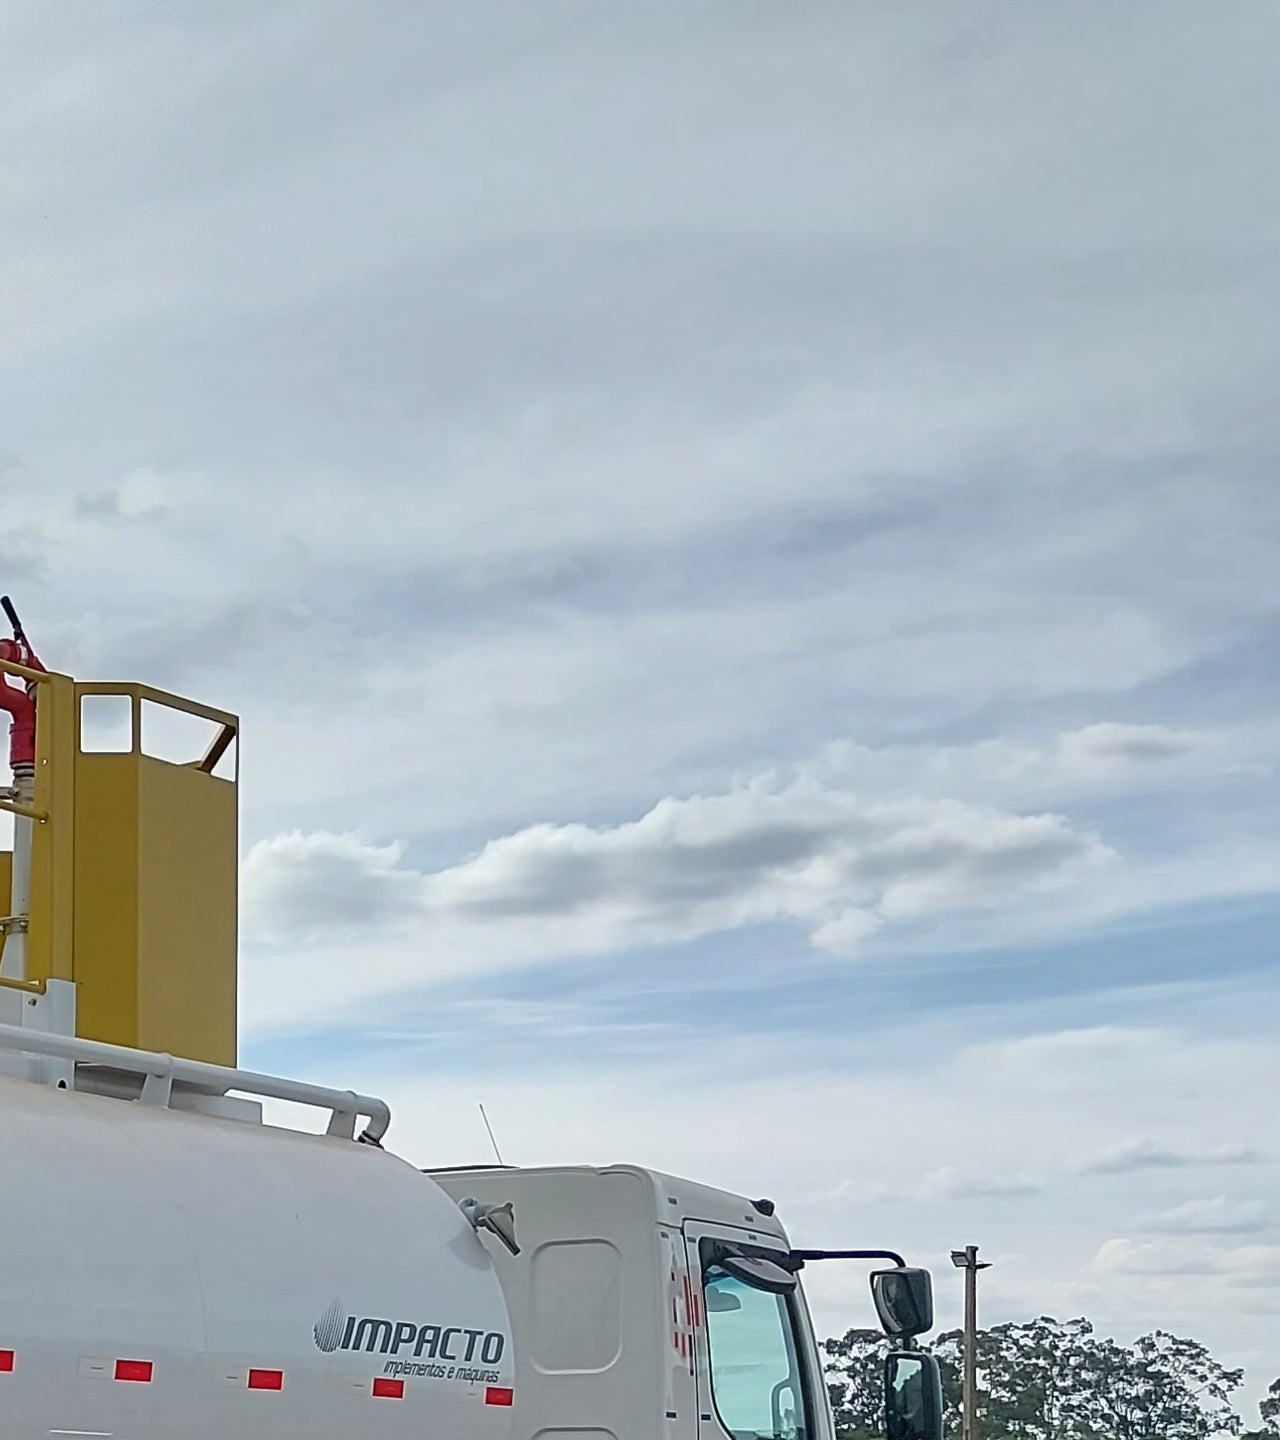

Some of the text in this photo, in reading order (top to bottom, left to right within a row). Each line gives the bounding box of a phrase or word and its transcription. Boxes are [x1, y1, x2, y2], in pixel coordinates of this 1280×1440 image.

[340, 1316, 505, 1364] IMPACTO
[383, 1360, 446, 1378] implementos
[447, 1368, 455, 1379] e
